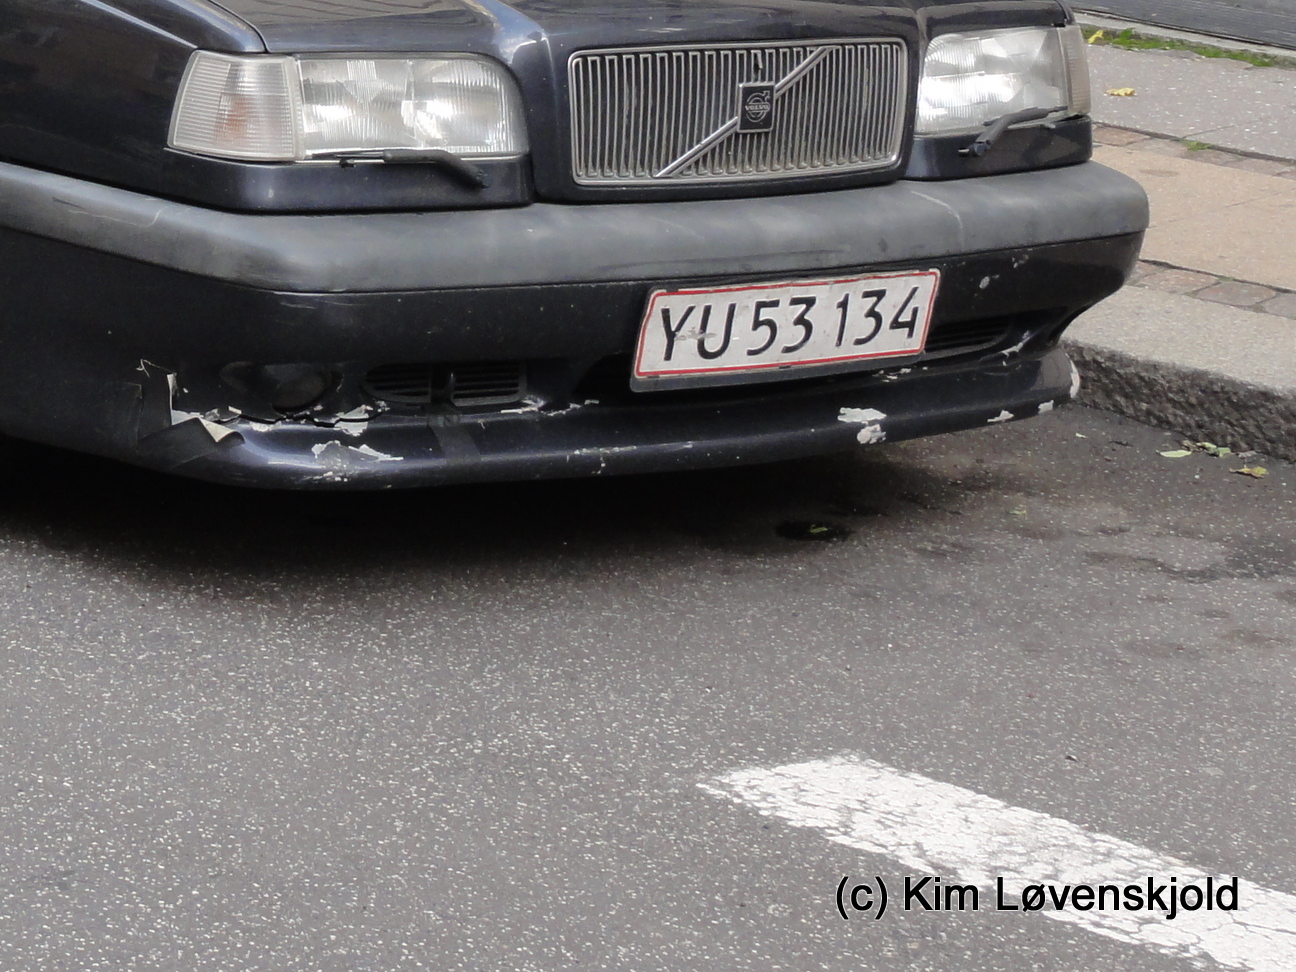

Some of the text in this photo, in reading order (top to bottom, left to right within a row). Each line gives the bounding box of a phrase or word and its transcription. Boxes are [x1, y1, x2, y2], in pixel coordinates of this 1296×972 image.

[660, 286, 919, 362] YU 53 134
